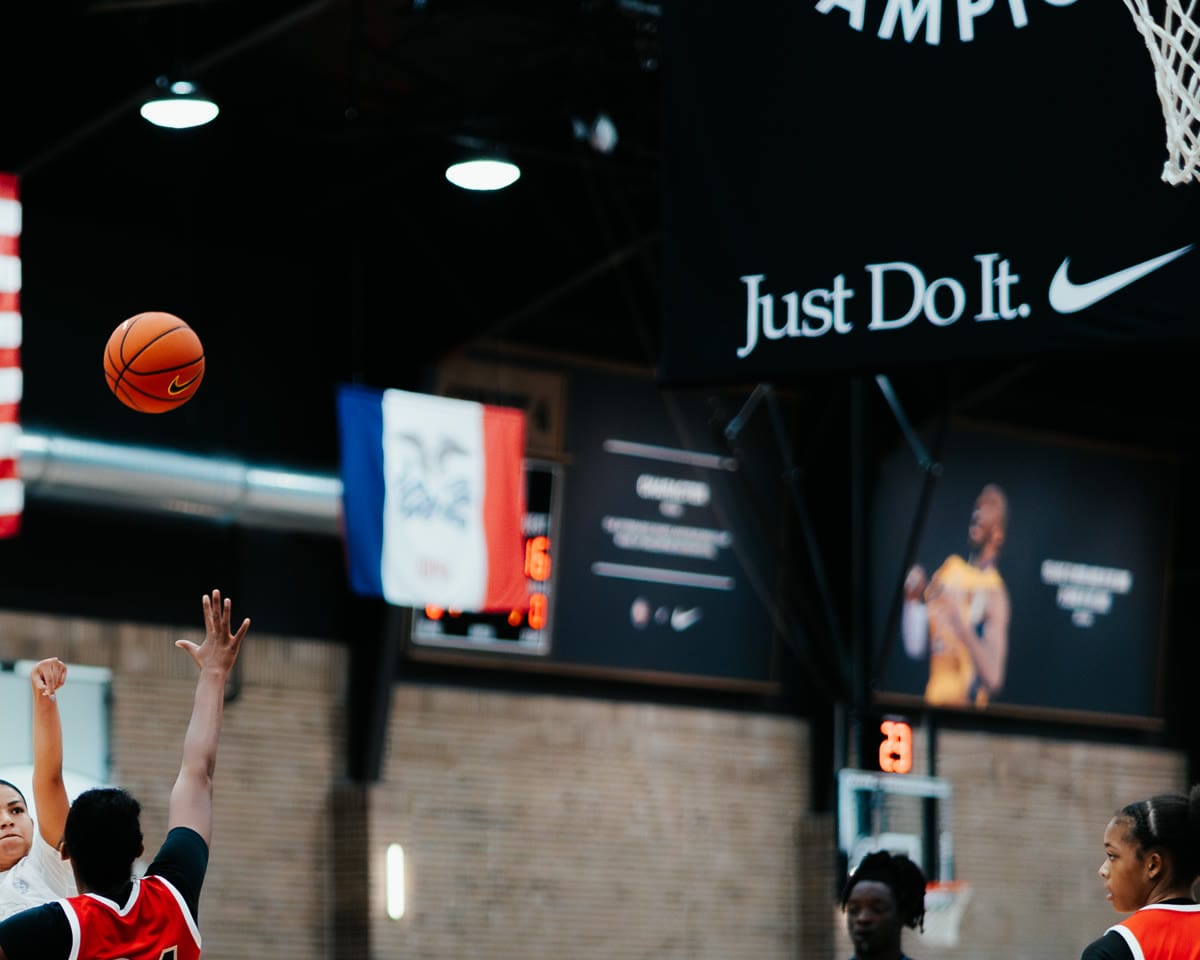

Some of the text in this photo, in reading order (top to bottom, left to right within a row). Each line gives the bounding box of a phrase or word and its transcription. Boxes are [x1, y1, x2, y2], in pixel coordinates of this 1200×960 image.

[737, 253, 1031, 358] Just Do It.
